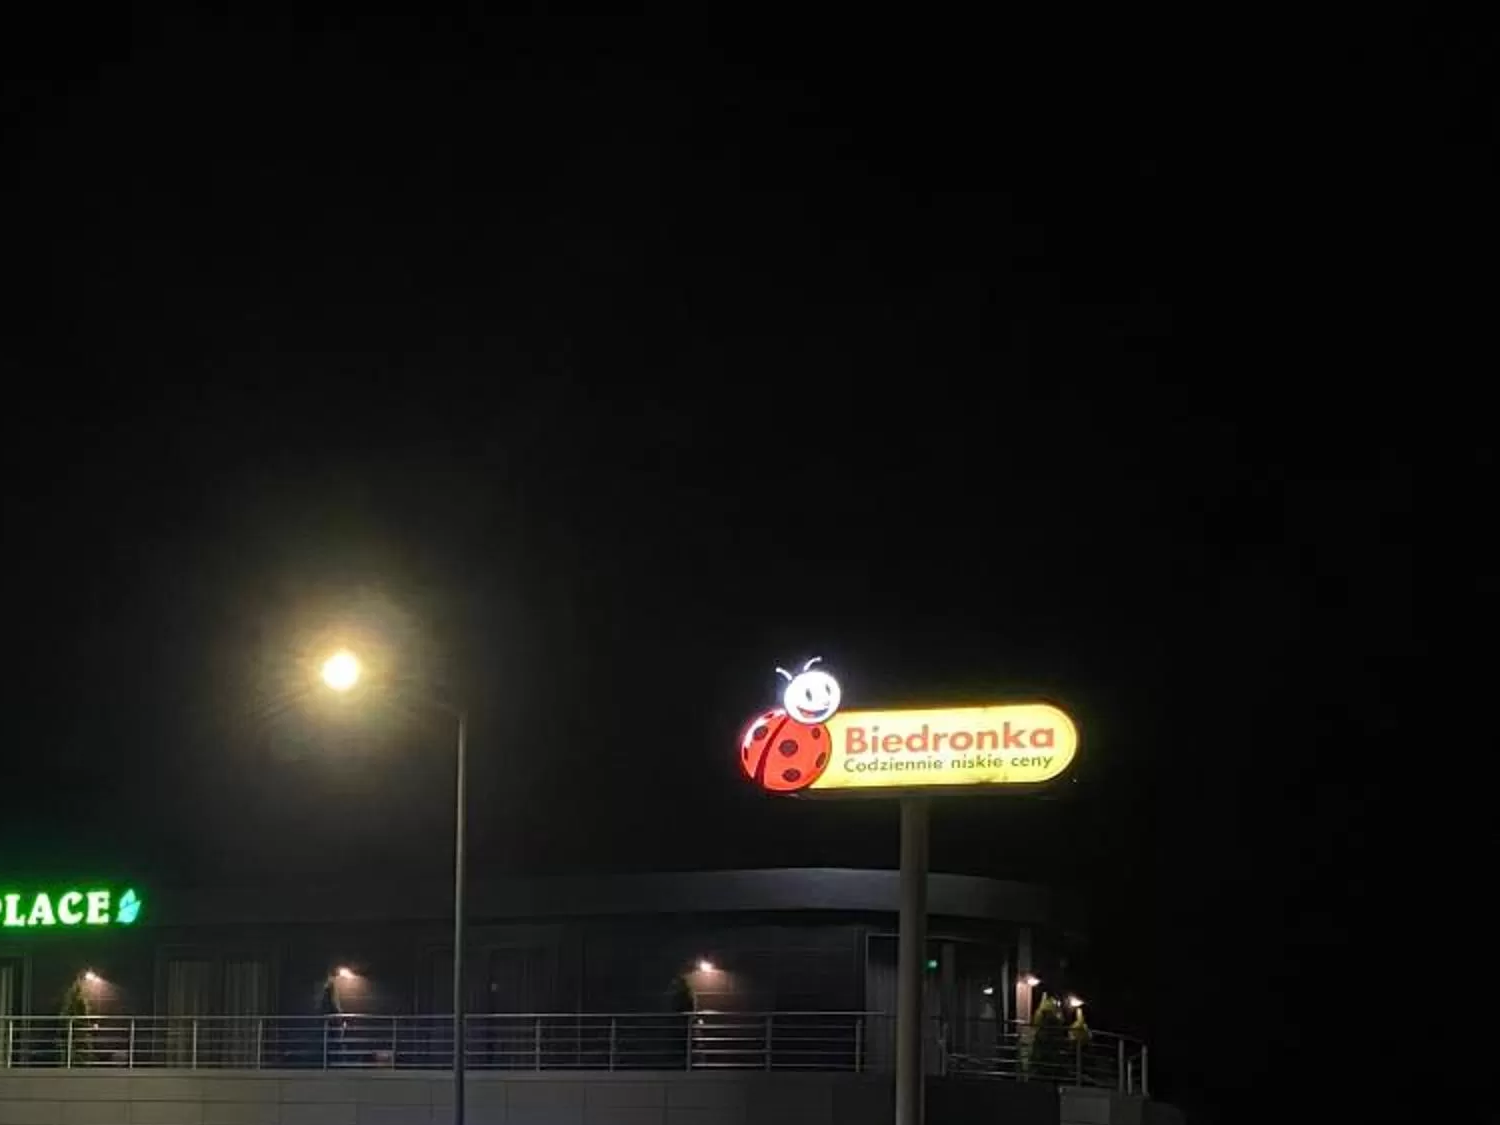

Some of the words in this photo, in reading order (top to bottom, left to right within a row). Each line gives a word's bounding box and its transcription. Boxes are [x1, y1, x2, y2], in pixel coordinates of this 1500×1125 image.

[845, 721, 1054, 755] Biedronka
[843, 757, 943, 773] Codziennie
[951, 753, 1002, 769] niskie
[1011, 756, 1053, 769] ceny
